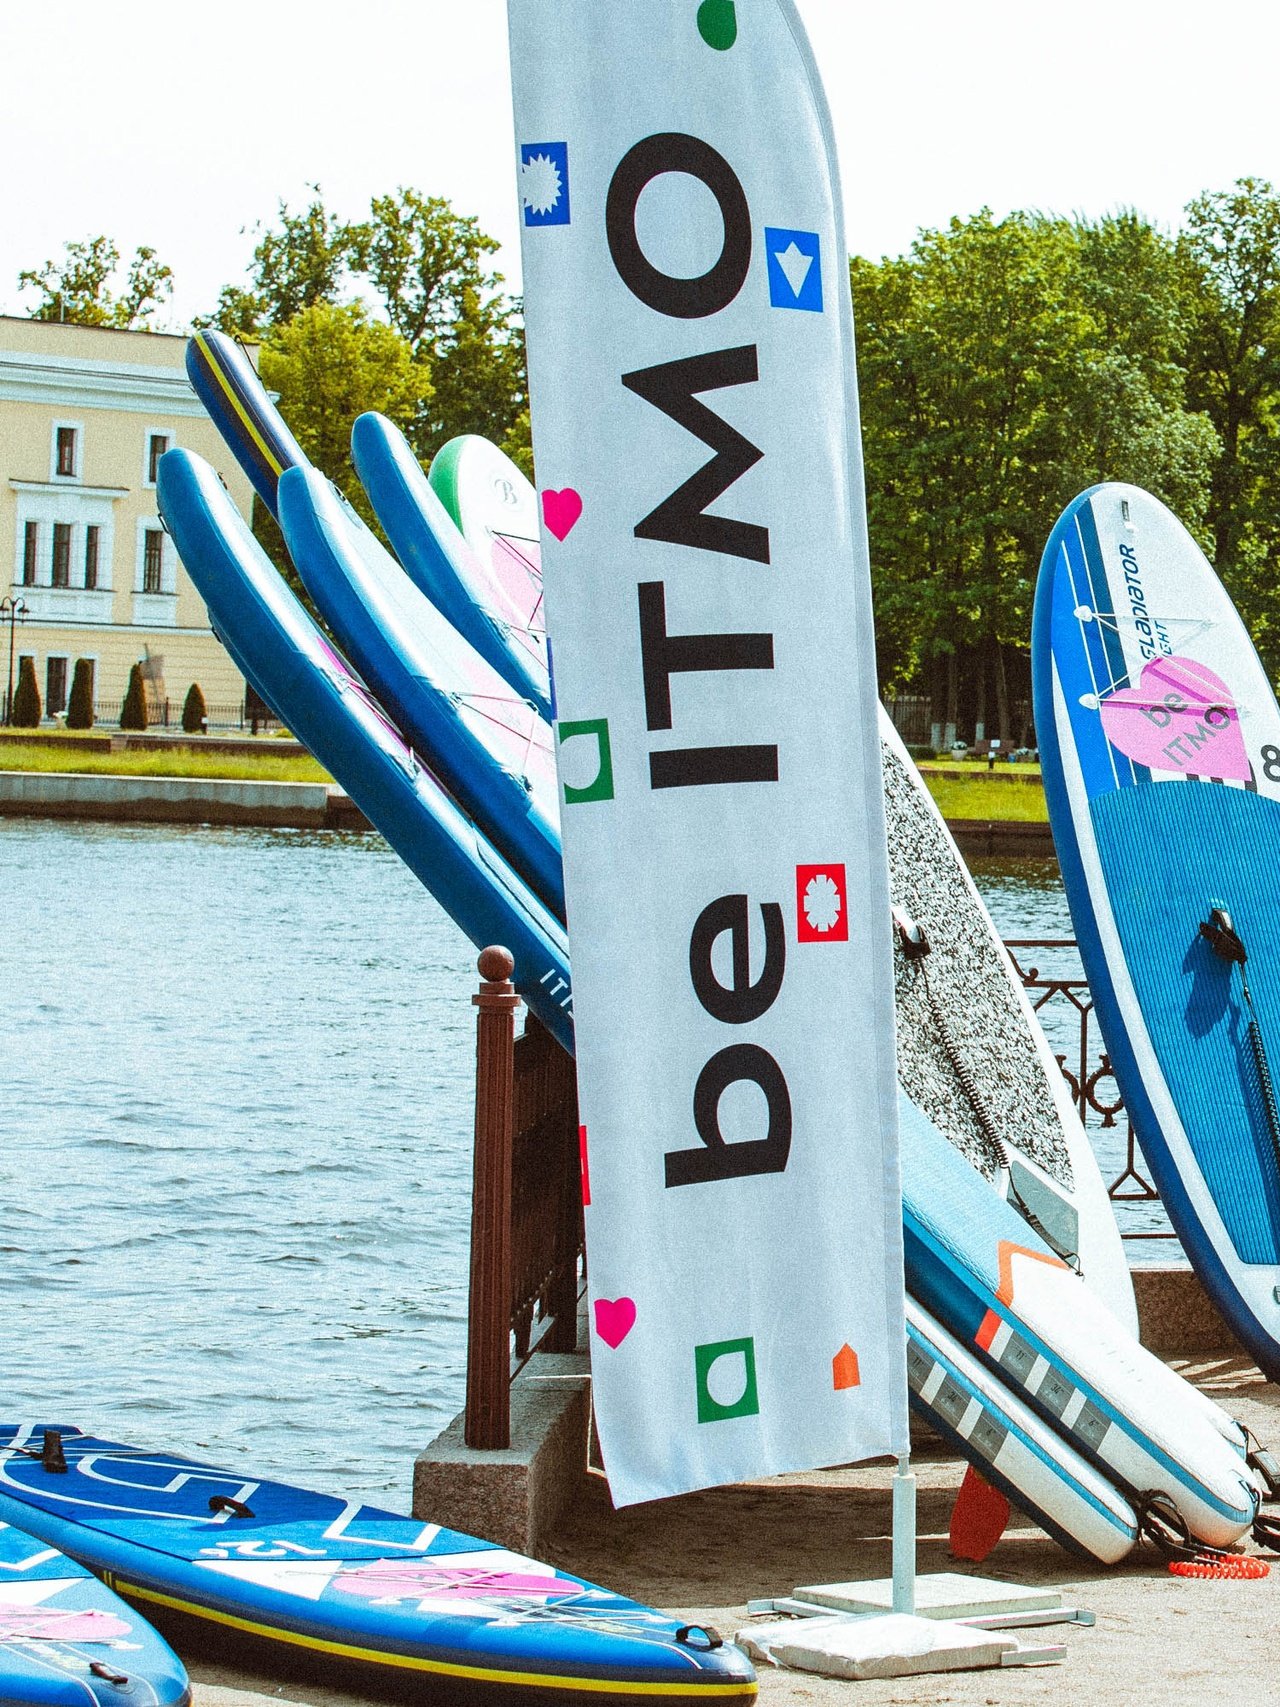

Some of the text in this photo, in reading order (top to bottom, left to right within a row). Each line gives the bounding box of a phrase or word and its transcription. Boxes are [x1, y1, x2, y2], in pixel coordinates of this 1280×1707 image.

[606, 133, 792, 1188] be ITMO
[1140, 692, 1188, 729] be
[1162, 705, 1232, 767] ITMO
